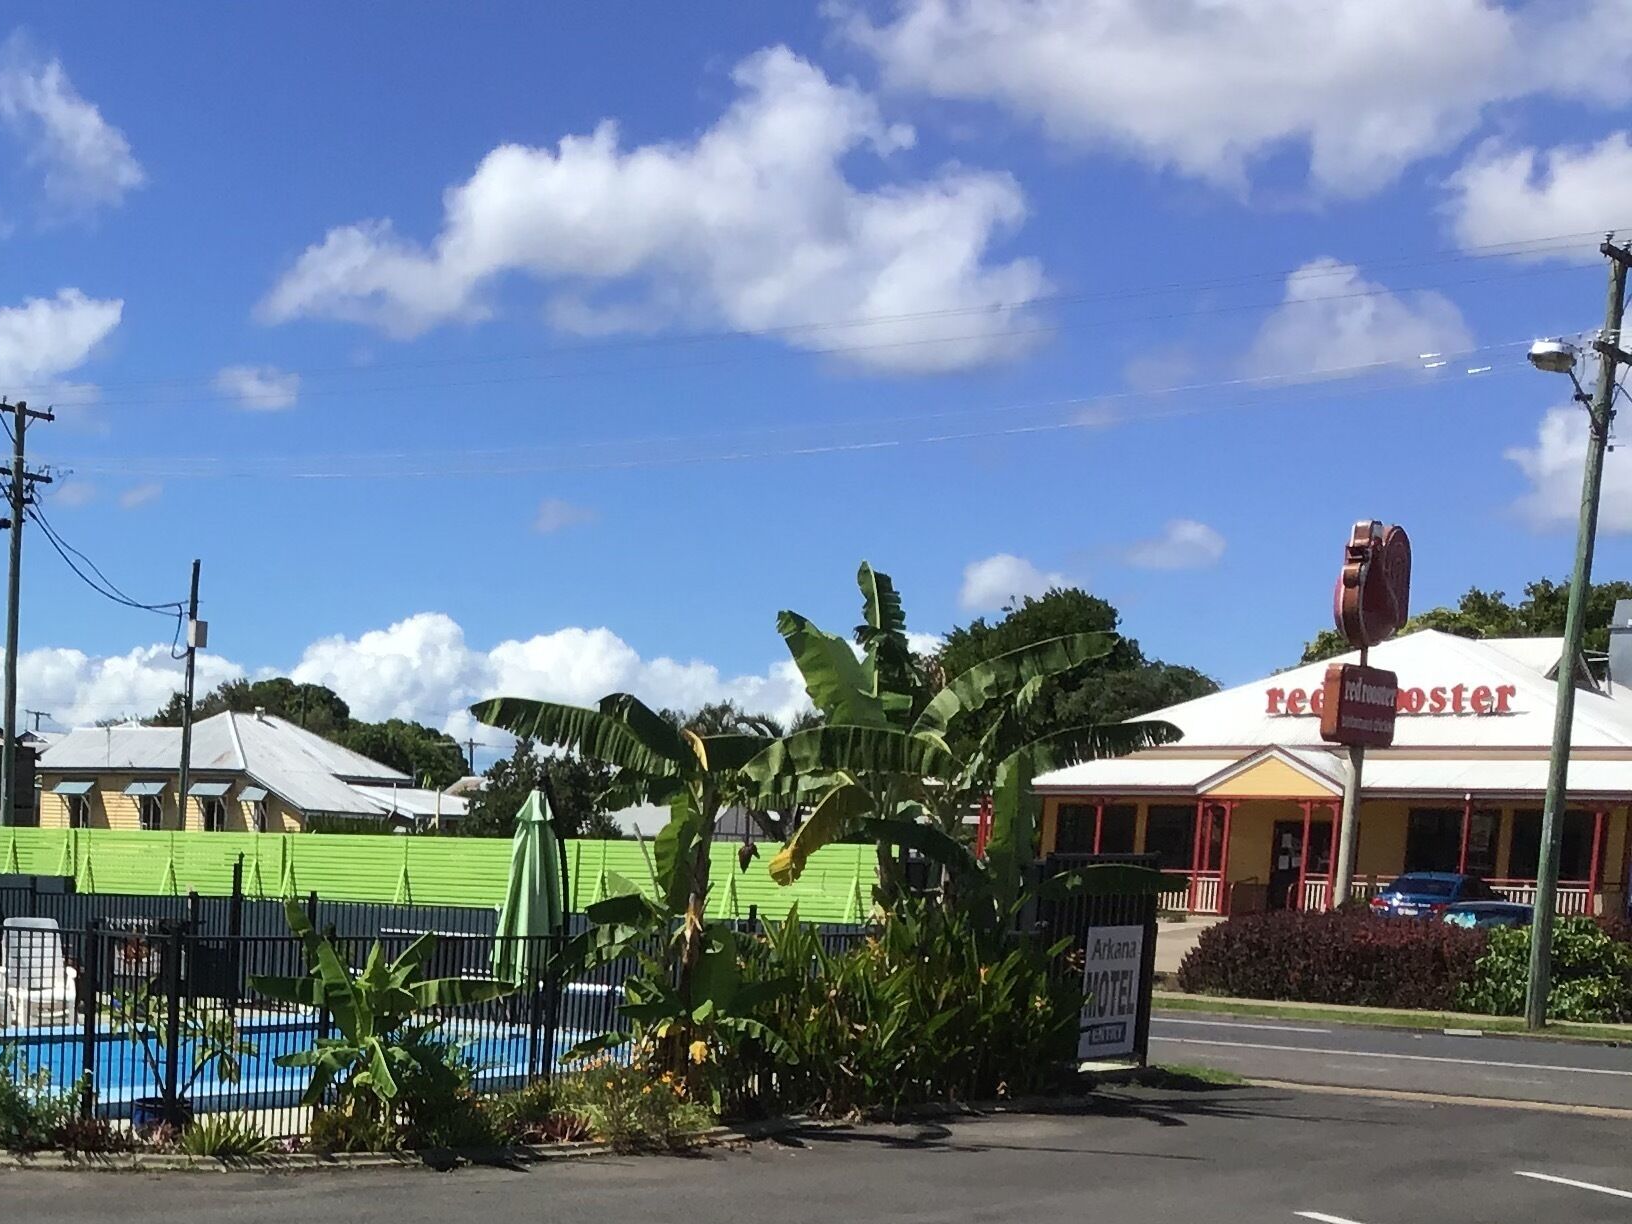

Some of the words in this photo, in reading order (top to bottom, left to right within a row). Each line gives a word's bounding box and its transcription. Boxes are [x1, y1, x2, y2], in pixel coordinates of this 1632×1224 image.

[1266, 683, 1325, 714] red
[1396, 683, 1515, 715] ooster
[1091, 938, 1137, 960] Arkana
[1084, 970, 1135, 1018] MOTEL
